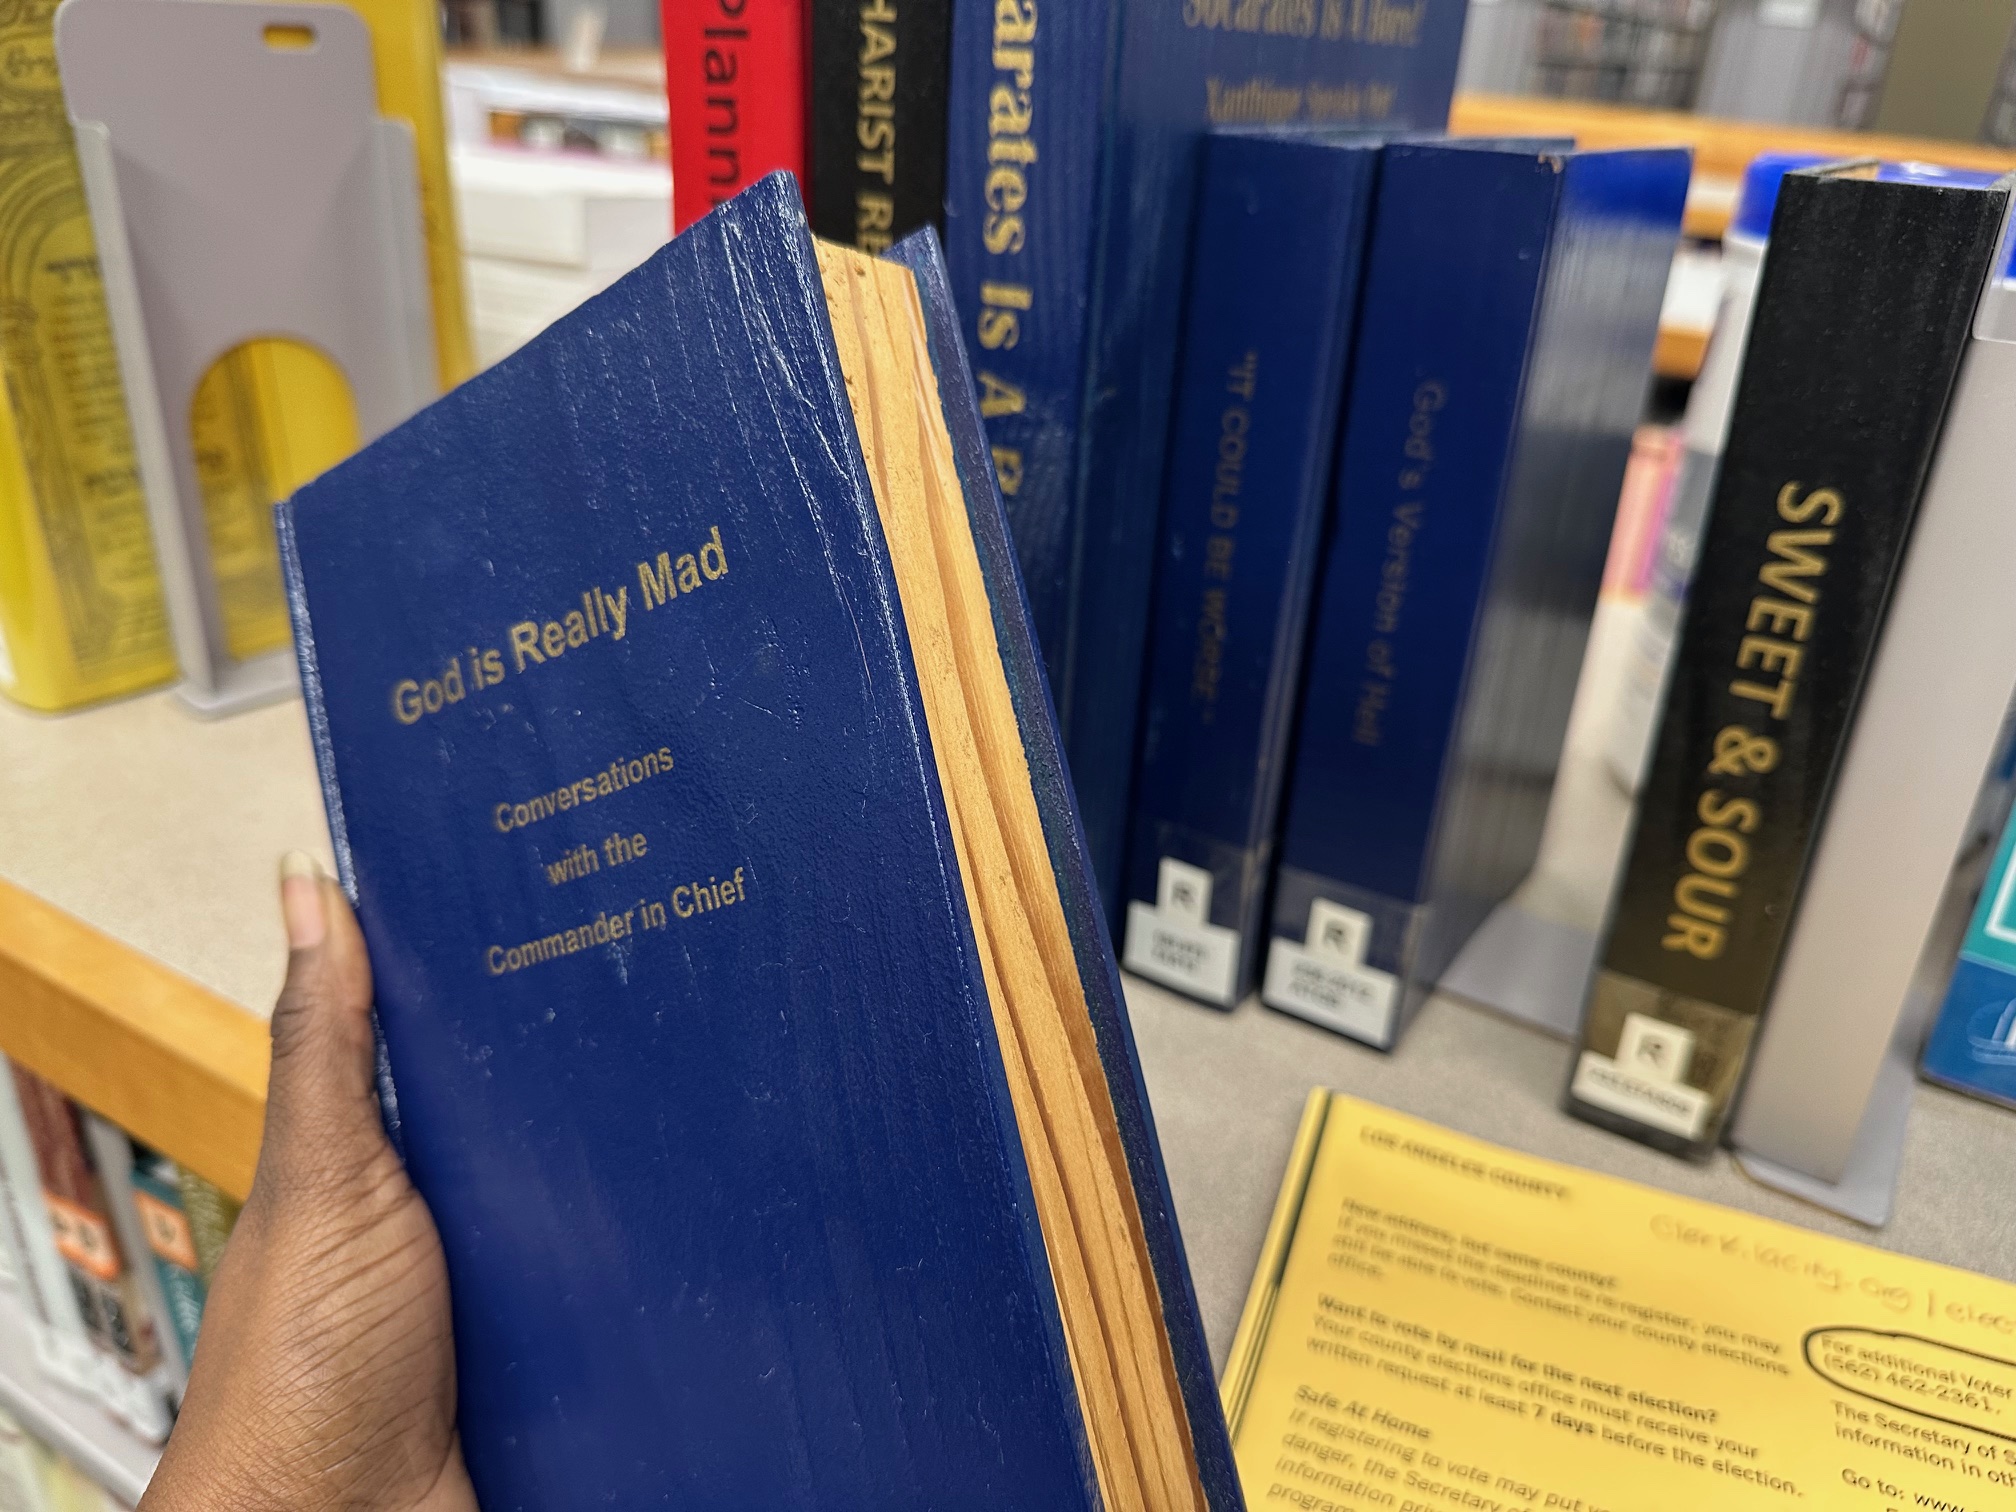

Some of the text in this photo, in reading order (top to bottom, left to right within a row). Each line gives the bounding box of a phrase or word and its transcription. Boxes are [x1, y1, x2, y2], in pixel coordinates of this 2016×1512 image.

[704, 0, 748, 206] lann
[977, 280, 1033, 350] Is
[976, 369, 1028, 418] A
[1210, 407, 1250, 530] COULD
[1205, 535, 1234, 580] BE
[1376, 501, 1422, 633] Version
[392, 525, 729, 725] God is Really Mad
[1367, 639, 1396, 678] of
[1661, 480, 1846, 961] SWEET & SOUR
[495, 746, 674, 833] Conversations
[547, 832, 648, 886] with the
[488, 866, 746, 976] Commander in Chief
[1489, 1167, 1573, 1199] COUNTY
[1318, 1292, 1719, 1424] Want to vote by mail for the next election?
[1510, 1286, 1583, 1318] Contact
[1587, 1311, 1629, 1332] your
[1632, 1322, 1697, 1352] county
[1701, 1341, 1791, 1376] elections
[1702, 1322, 1736, 1341] you
[1741, 1333, 1783, 1355] may
[1313, 1313, 1760, 1460] Your county elections office must receive your
[1821, 1334, 2013, 1400] For additional Voter
[1823, 1352, 1880, 1382] (562)
[1297, 1384, 1432, 1439] Safe At Home
[1307, 1336, 1805, 1497] written request at least 7 days before the election.
[1831, 1399, 1870, 1423] The
[1874, 1412, 1970, 1454] Secretary
[1977, 1443, 1998, 1460] of
[1275, 1456, 1397, 1506] information
[1282, 1433, 1501, 1512] danger, the Secretary
[1290, 1407, 1307, 1423] If
[1308, 1416, 1418, 1463] registering
[1421, 1451, 1441, 1467] to
[1448, 1461, 1489, 1484] vote
[1495, 1477, 1539, 1501] may
[1544, 1492, 1585, 1512] put
[1835, 1421, 1954, 1471] information
[1961, 1458, 1981, 1478] in
[1842, 1468, 1870, 1489] Go
[1877, 1479, 1904, 1500] to:
